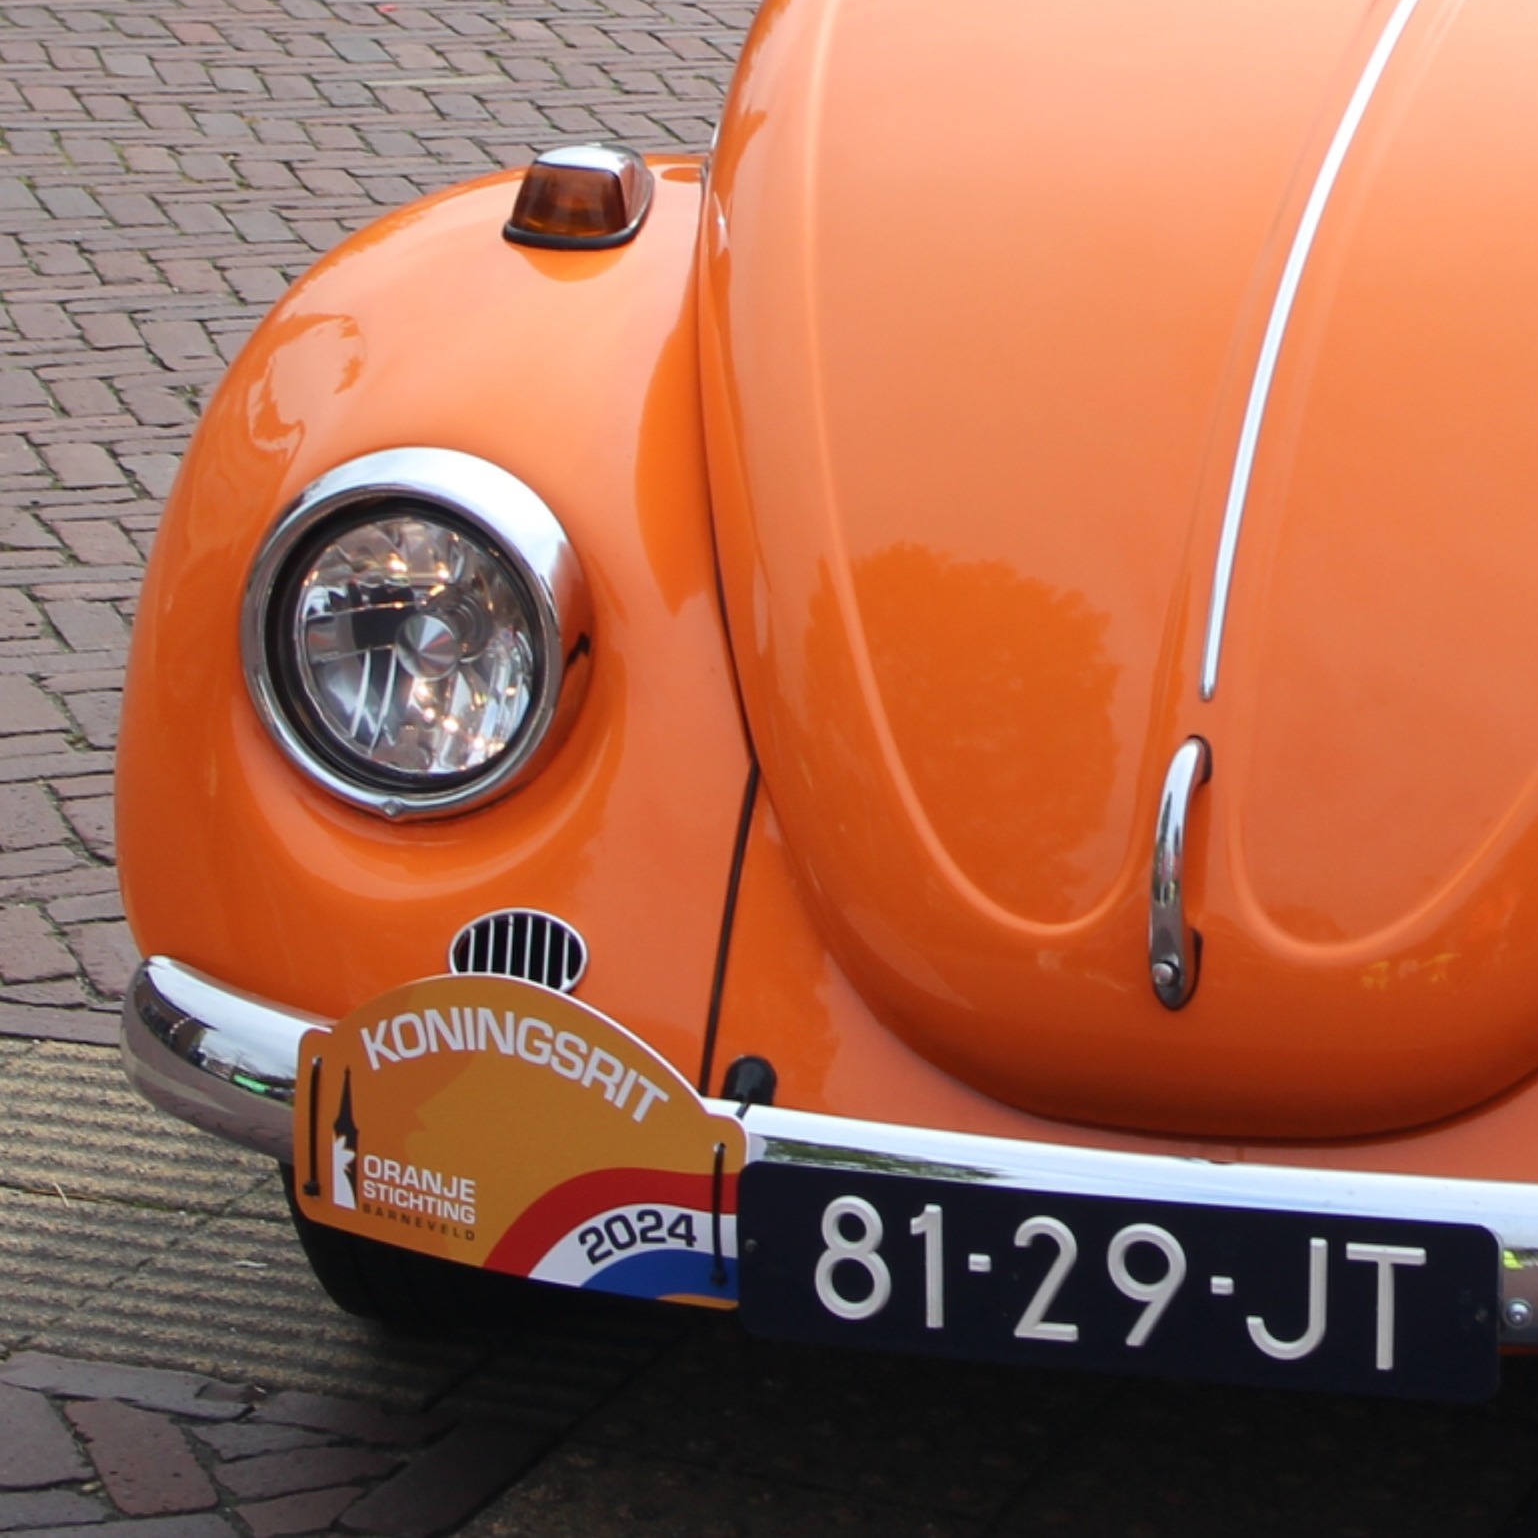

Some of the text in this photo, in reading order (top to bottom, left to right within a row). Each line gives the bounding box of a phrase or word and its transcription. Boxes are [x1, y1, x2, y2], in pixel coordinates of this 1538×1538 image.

[360, 1007, 669, 1123] KONINGSRIT
[363, 1154, 476, 1204] ORANJE
[363, 1180, 476, 1224] STICHTING
[362, 1203, 476, 1241] BARNEVELD
[578, 1209, 697, 1266] 2024
[814, 1194, 1427, 1370] 81-29-JT
